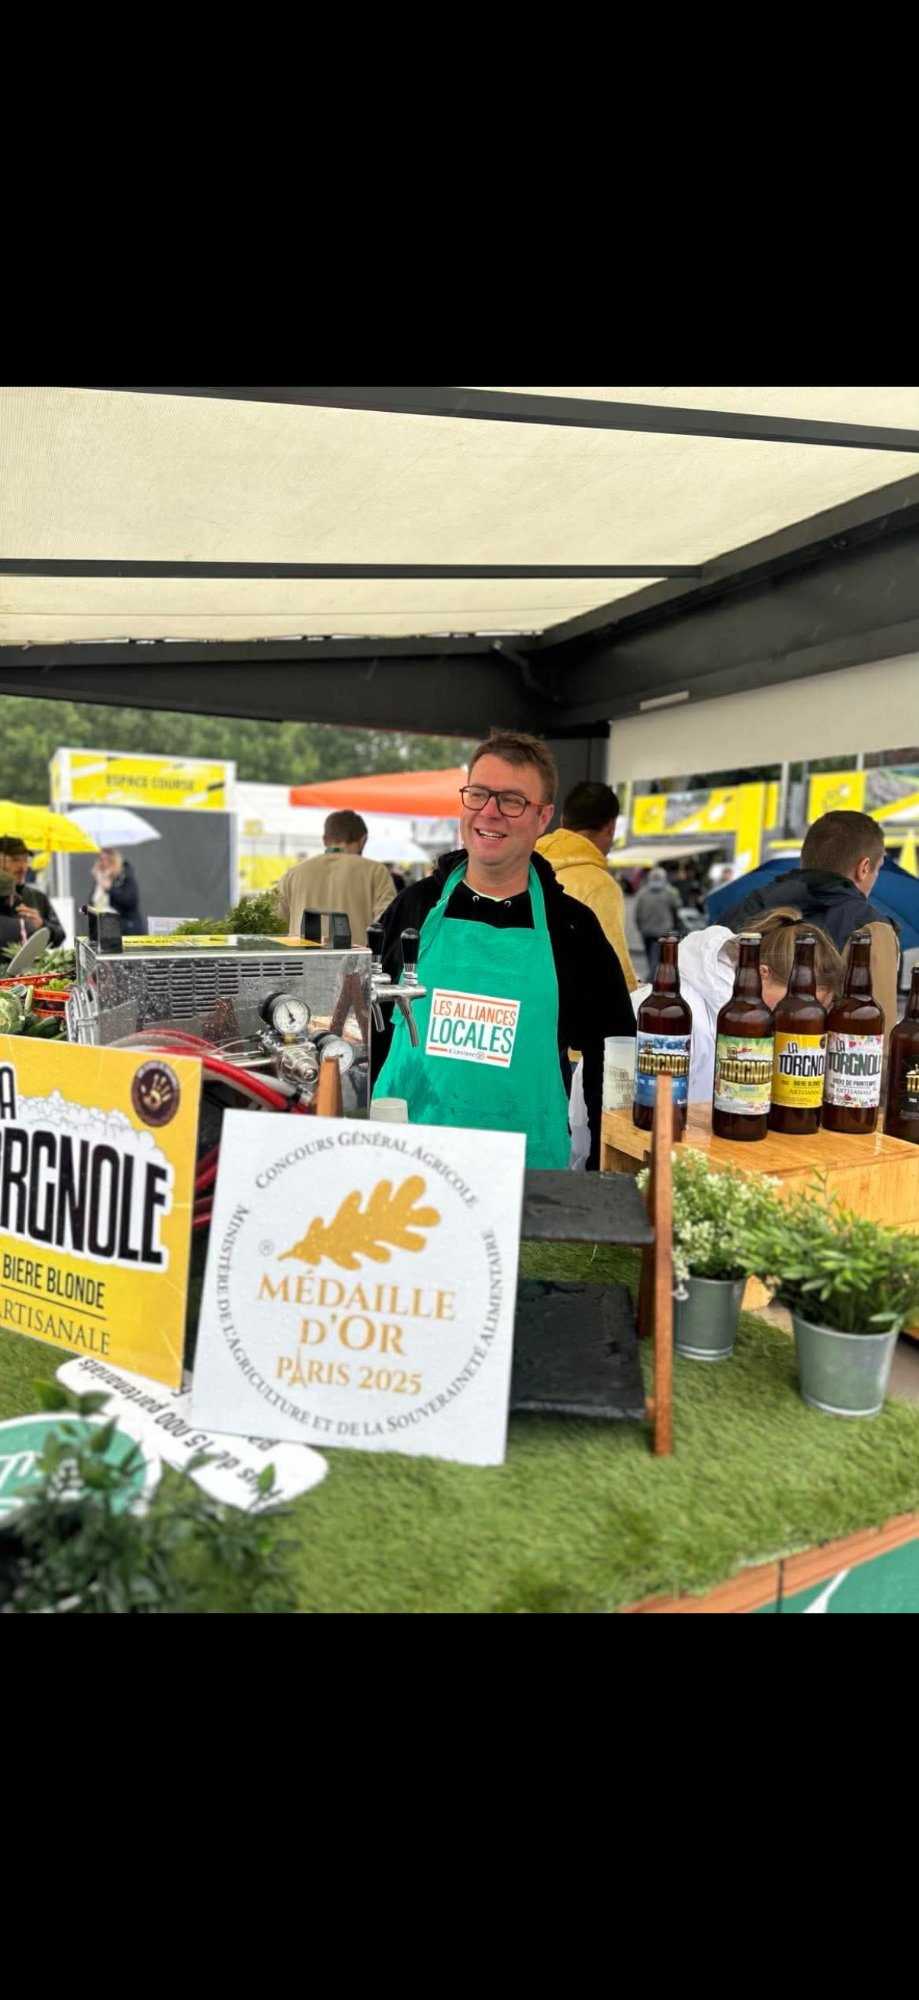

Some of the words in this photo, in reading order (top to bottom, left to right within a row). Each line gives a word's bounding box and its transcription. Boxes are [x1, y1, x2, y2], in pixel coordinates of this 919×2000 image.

[430, 1017, 514, 1055] LOCALES
[433, 999, 452, 1017] LES
[453, 1002, 517, 1027] ALLIANCES
[787, 1042, 798, 1054] LA
[835, 1040, 846, 1052] LA
[255, 1136, 334, 1189] CONCOURS
[337, 1130, 409, 1154] GÉNÉRAL
[410, 1146, 478, 1209] AGRICOLE
[0, 1127, 168, 1266] RGNOLE
[3, 1253, 43, 1290] BIERE
[47, 1266, 106, 1310] BLONDE
[258, 1268, 456, 1321] MÉDAILLE
[217, 1298, 232, 1323] DE
[312, 1414, 334, 1433] ET
[336, 1420, 360, 1436] DE
[362, 1421, 384, 1437] LA
[479, 1228, 503, 1348] ALIMENTAIRE
[79, 1358, 170, 1414] partenariats
[275, 1347, 350, 1389] PARIS
[359, 1365, 423, 1396] 2025
[153, 1411, 192, 1438] 000
